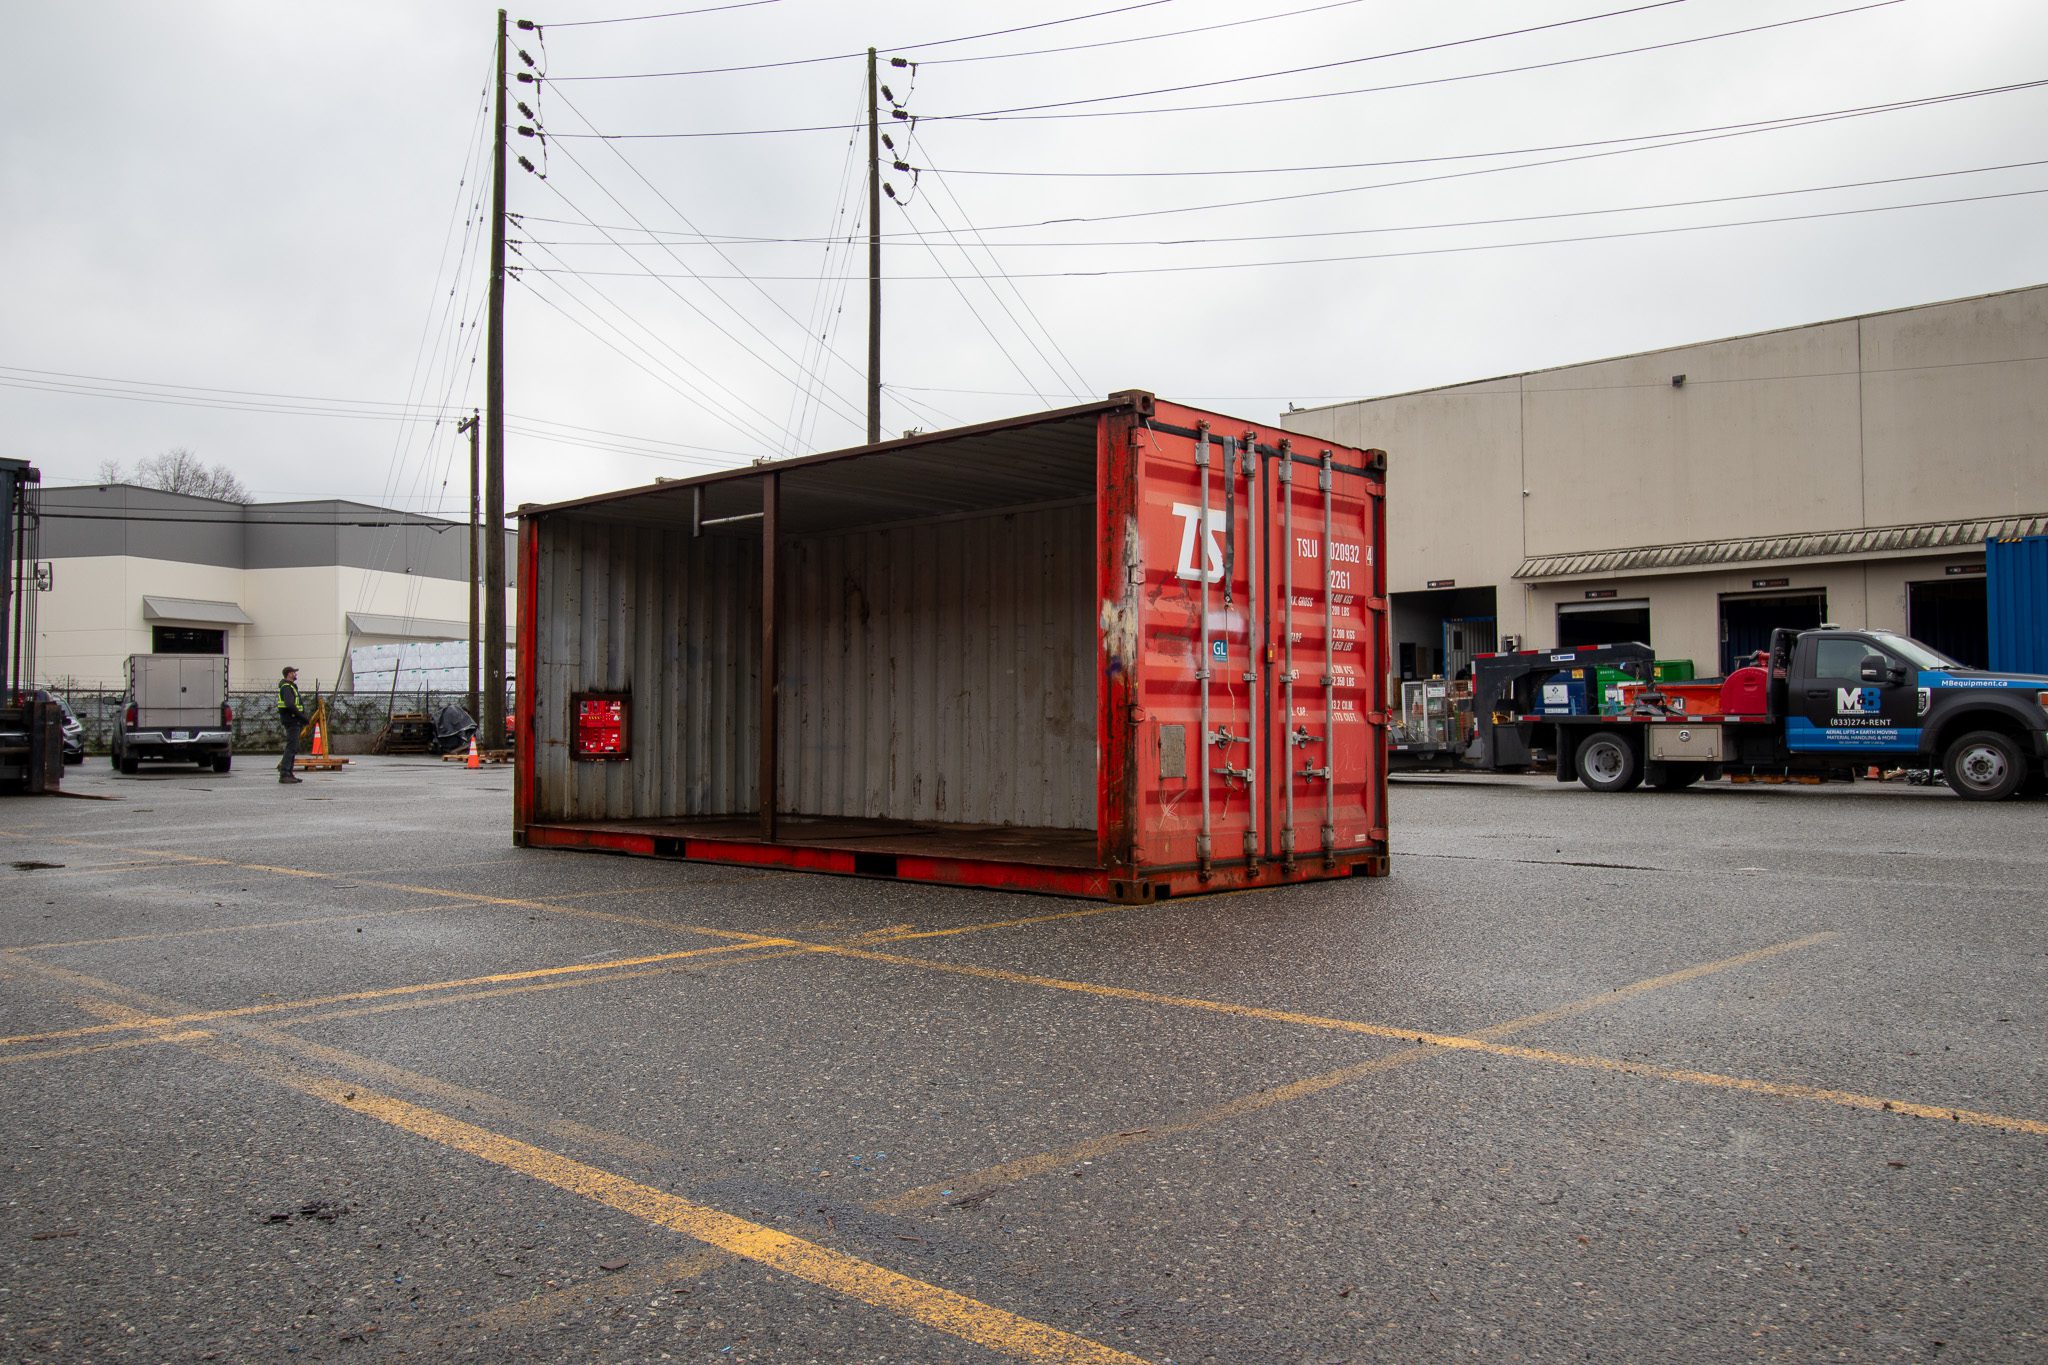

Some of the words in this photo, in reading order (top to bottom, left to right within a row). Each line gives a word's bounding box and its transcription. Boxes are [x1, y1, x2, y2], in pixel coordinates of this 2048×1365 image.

[1296, 538, 1318, 558] TSLU
[1331, 542, 1360, 563] 020932
[1366, 546, 1373, 566] 4
[1331, 570, 1350, 589] 22G1
[1298, 597, 1314, 607] GROSS
[1341, 606, 1350, 617] LBS
[1346, 630, 1356, 640] KGS
[1213, 641, 1227, 656] GL
[1343, 642, 1354, 652] LBS
[1346, 677, 1355, 687] LBS
[1941, 679, 2008, 688] MBequipment.ca
[1837, 687, 1881, 712] M&B
[1830, 718, 1892, 727] (833)274-RENT
